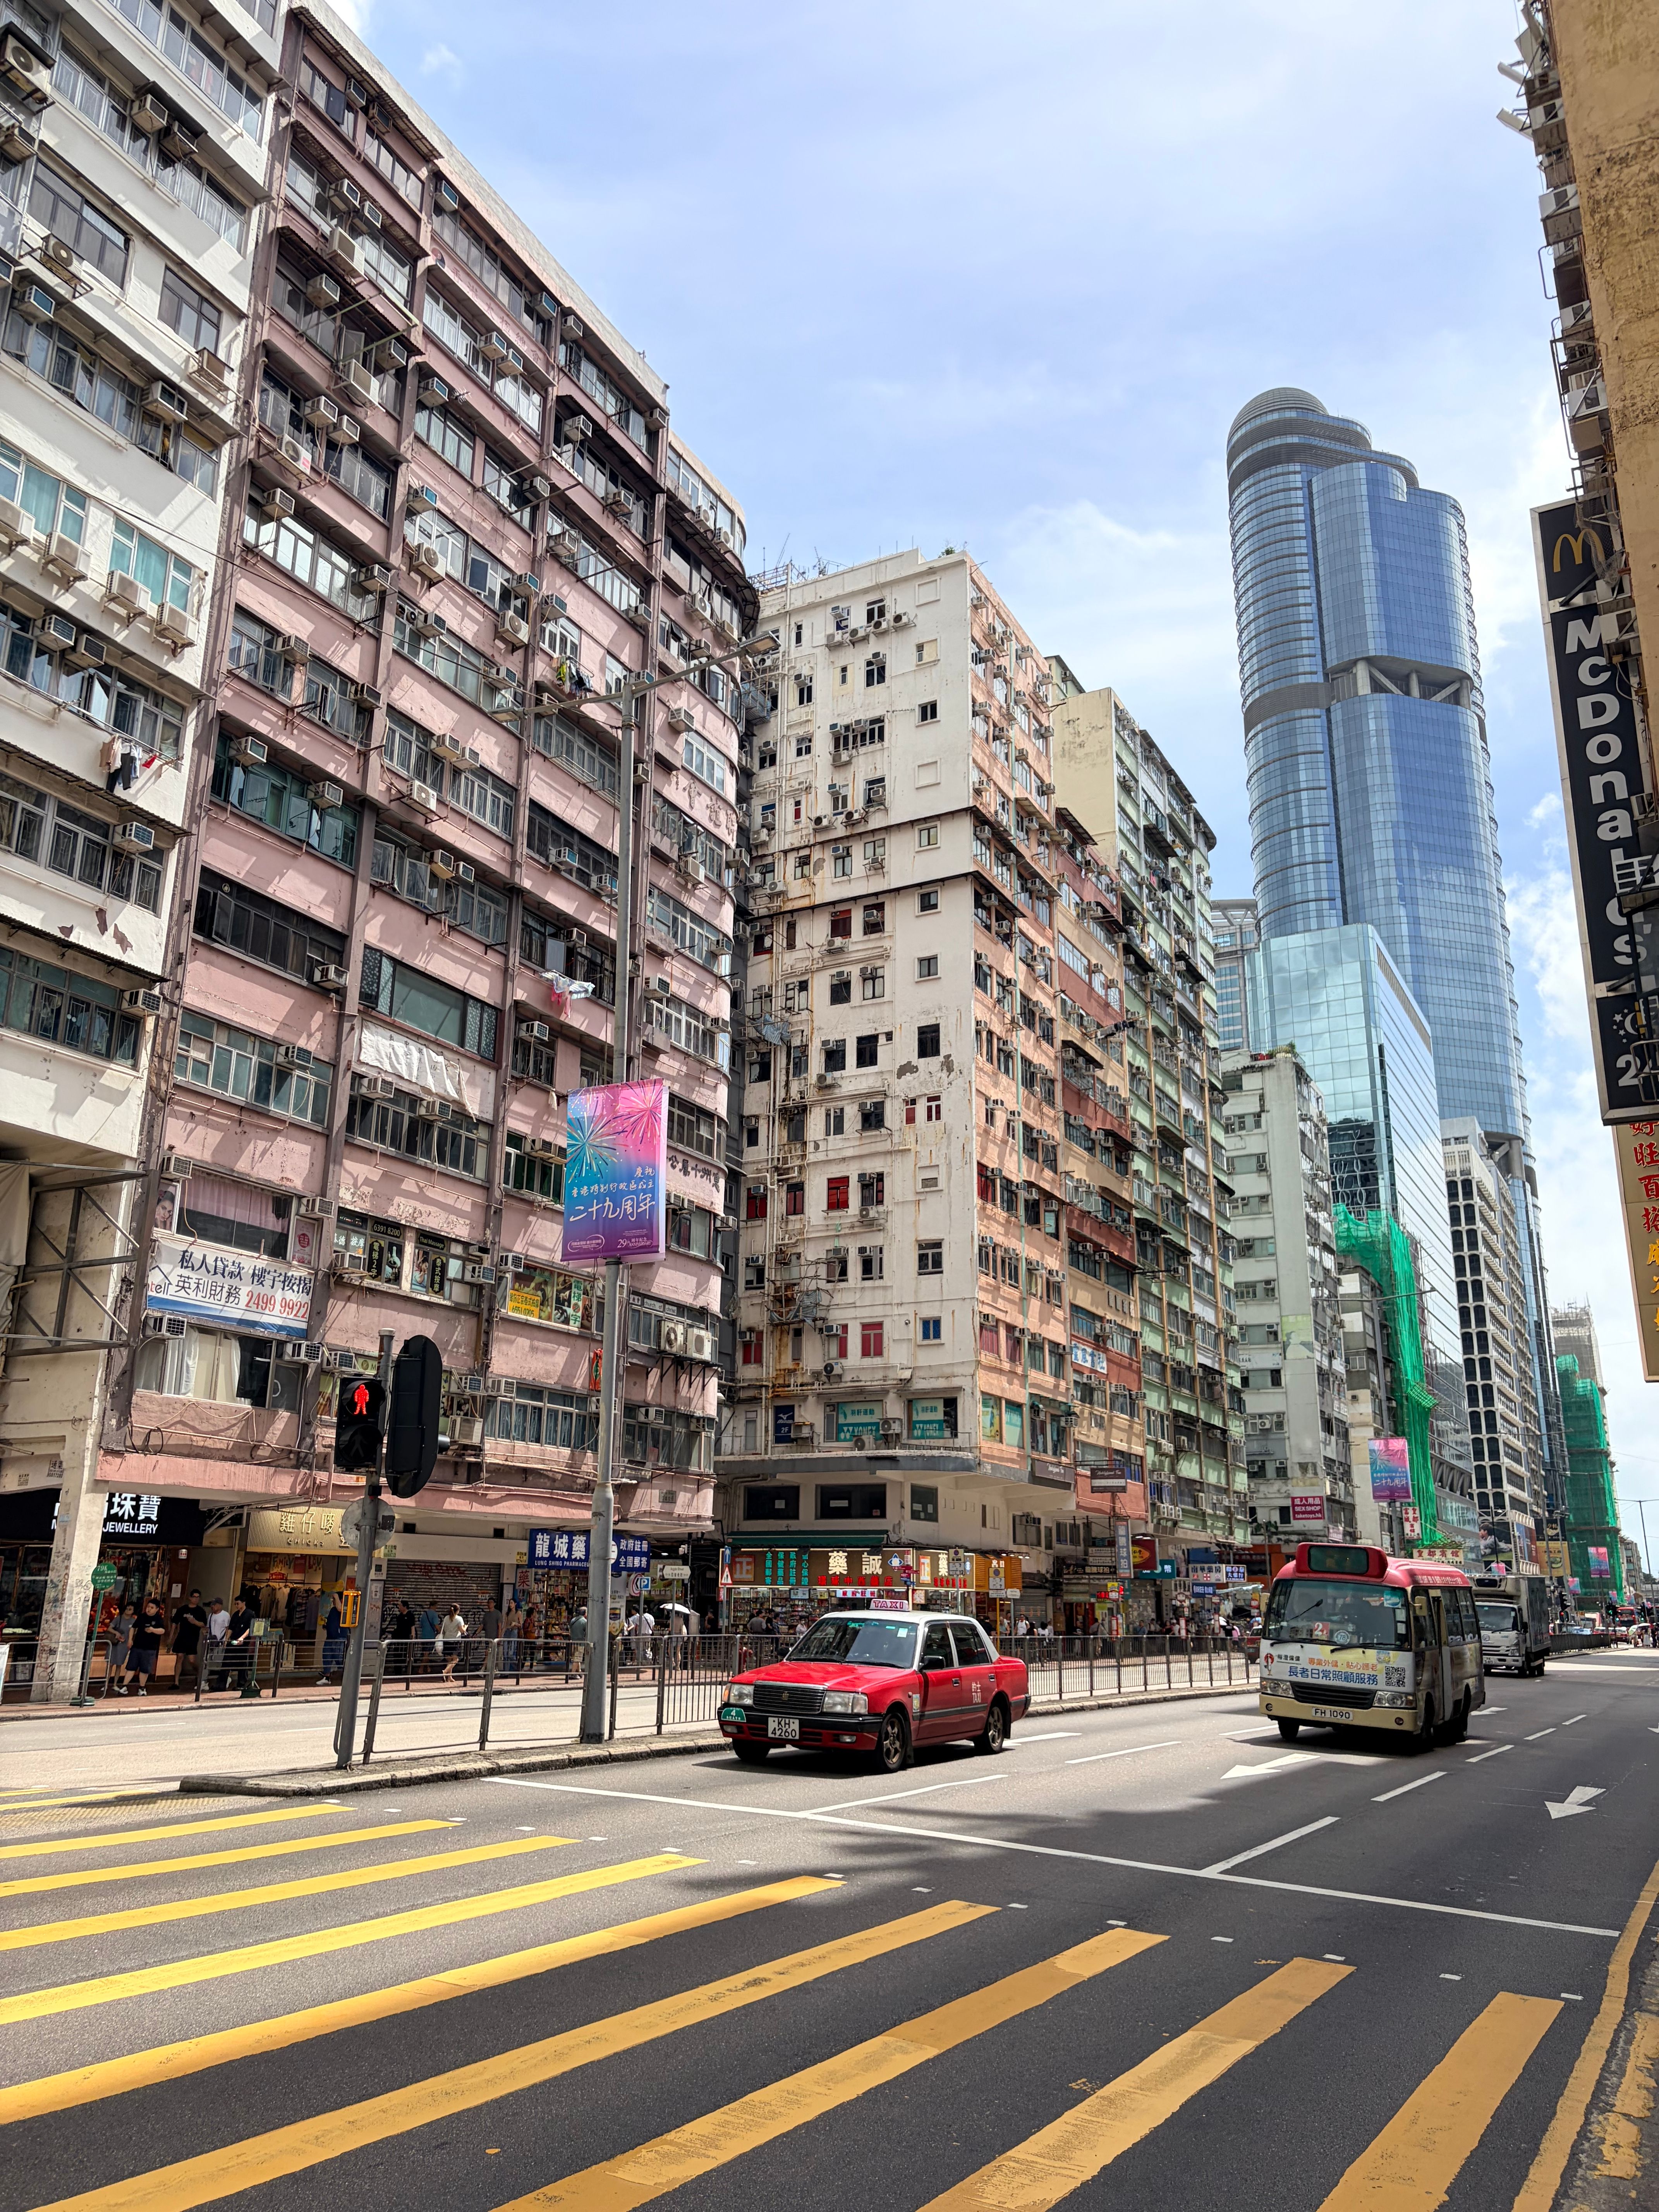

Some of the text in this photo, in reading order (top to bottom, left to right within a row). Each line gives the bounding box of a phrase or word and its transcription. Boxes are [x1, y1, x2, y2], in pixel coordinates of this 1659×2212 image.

[666, 1155, 720, 1194] 惠州十屬公
[569, 1193, 656, 1221] 二十九周年
[374, 1224, 400, 1237] 6391 8200
[428, 1239, 445, 1249] Massage
[371, 1242, 380, 1277] 電梯2字
[179, 1249, 312, 1296] 私人貸款 樓宇按揭
[174, 1274, 242, 1305] 英利財務
[245, 1290, 309, 1319] 2499 9922
[571, 1279, 583, 1325] 電梯2字
[644, 1300, 656, 1309] church
[854, 1426, 876, 1436] YONEX
[923, 1424, 939, 1436] YONEX
[103, 1522, 158, 1534] JEWELLERY
[280, 1512, 335, 1535] 雞仔嘜
[535, 1532, 587, 1560] 龍城藥
[620, 1539, 648, 1552] 政府註冊
[619, 1556, 647, 1568] 全國郵寄
[517, 1570, 531, 1588] 藥
[641, 1579, 647, 1587] P
[873, 1600, 903, 1608] TAXI
[1288, 1666, 1378, 1685] 長者日常照顧服務
[972, 1681, 981, 1692] 的士
[972, 1692, 981, 1703] TAXI
[1329, 1711, 1350, 1719] 1090
[778, 1718, 790, 1728] KH
[771, 1727, 797, 1738] 4260
